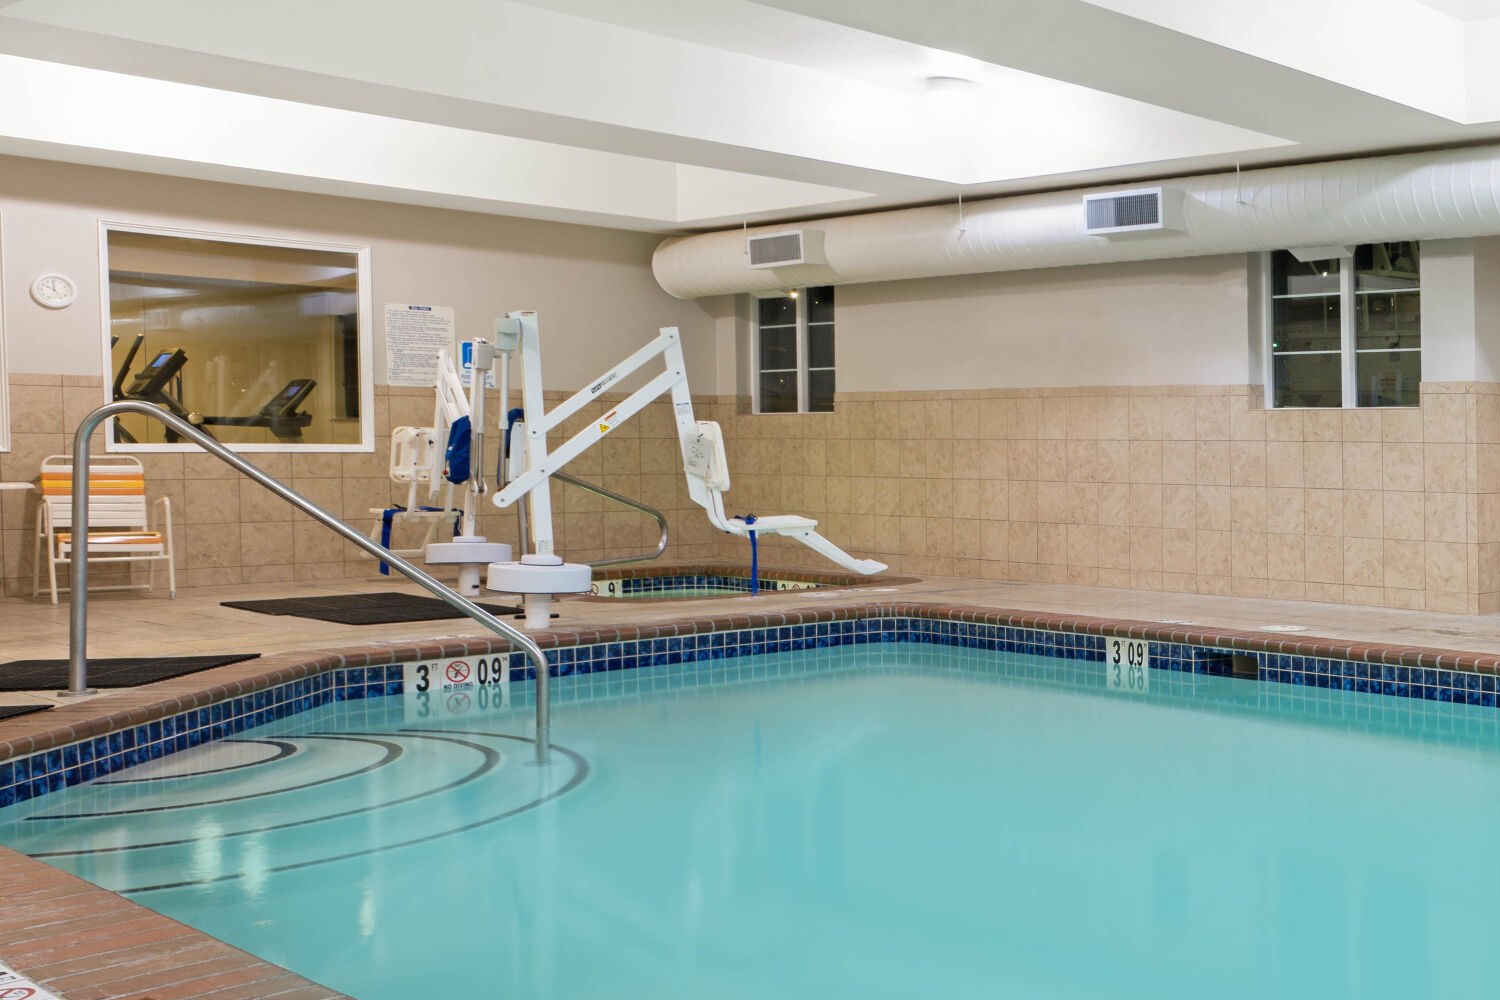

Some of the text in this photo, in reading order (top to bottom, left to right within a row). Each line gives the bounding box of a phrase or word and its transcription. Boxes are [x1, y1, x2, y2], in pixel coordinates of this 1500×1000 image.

[1113, 641, 1121, 664] 3
[1128, 642, 1143, 666] 0.9
[416, 665, 429, 692] 3
[432, 663, 438, 671] FT
[478, 658, 502, 685] 0.9
